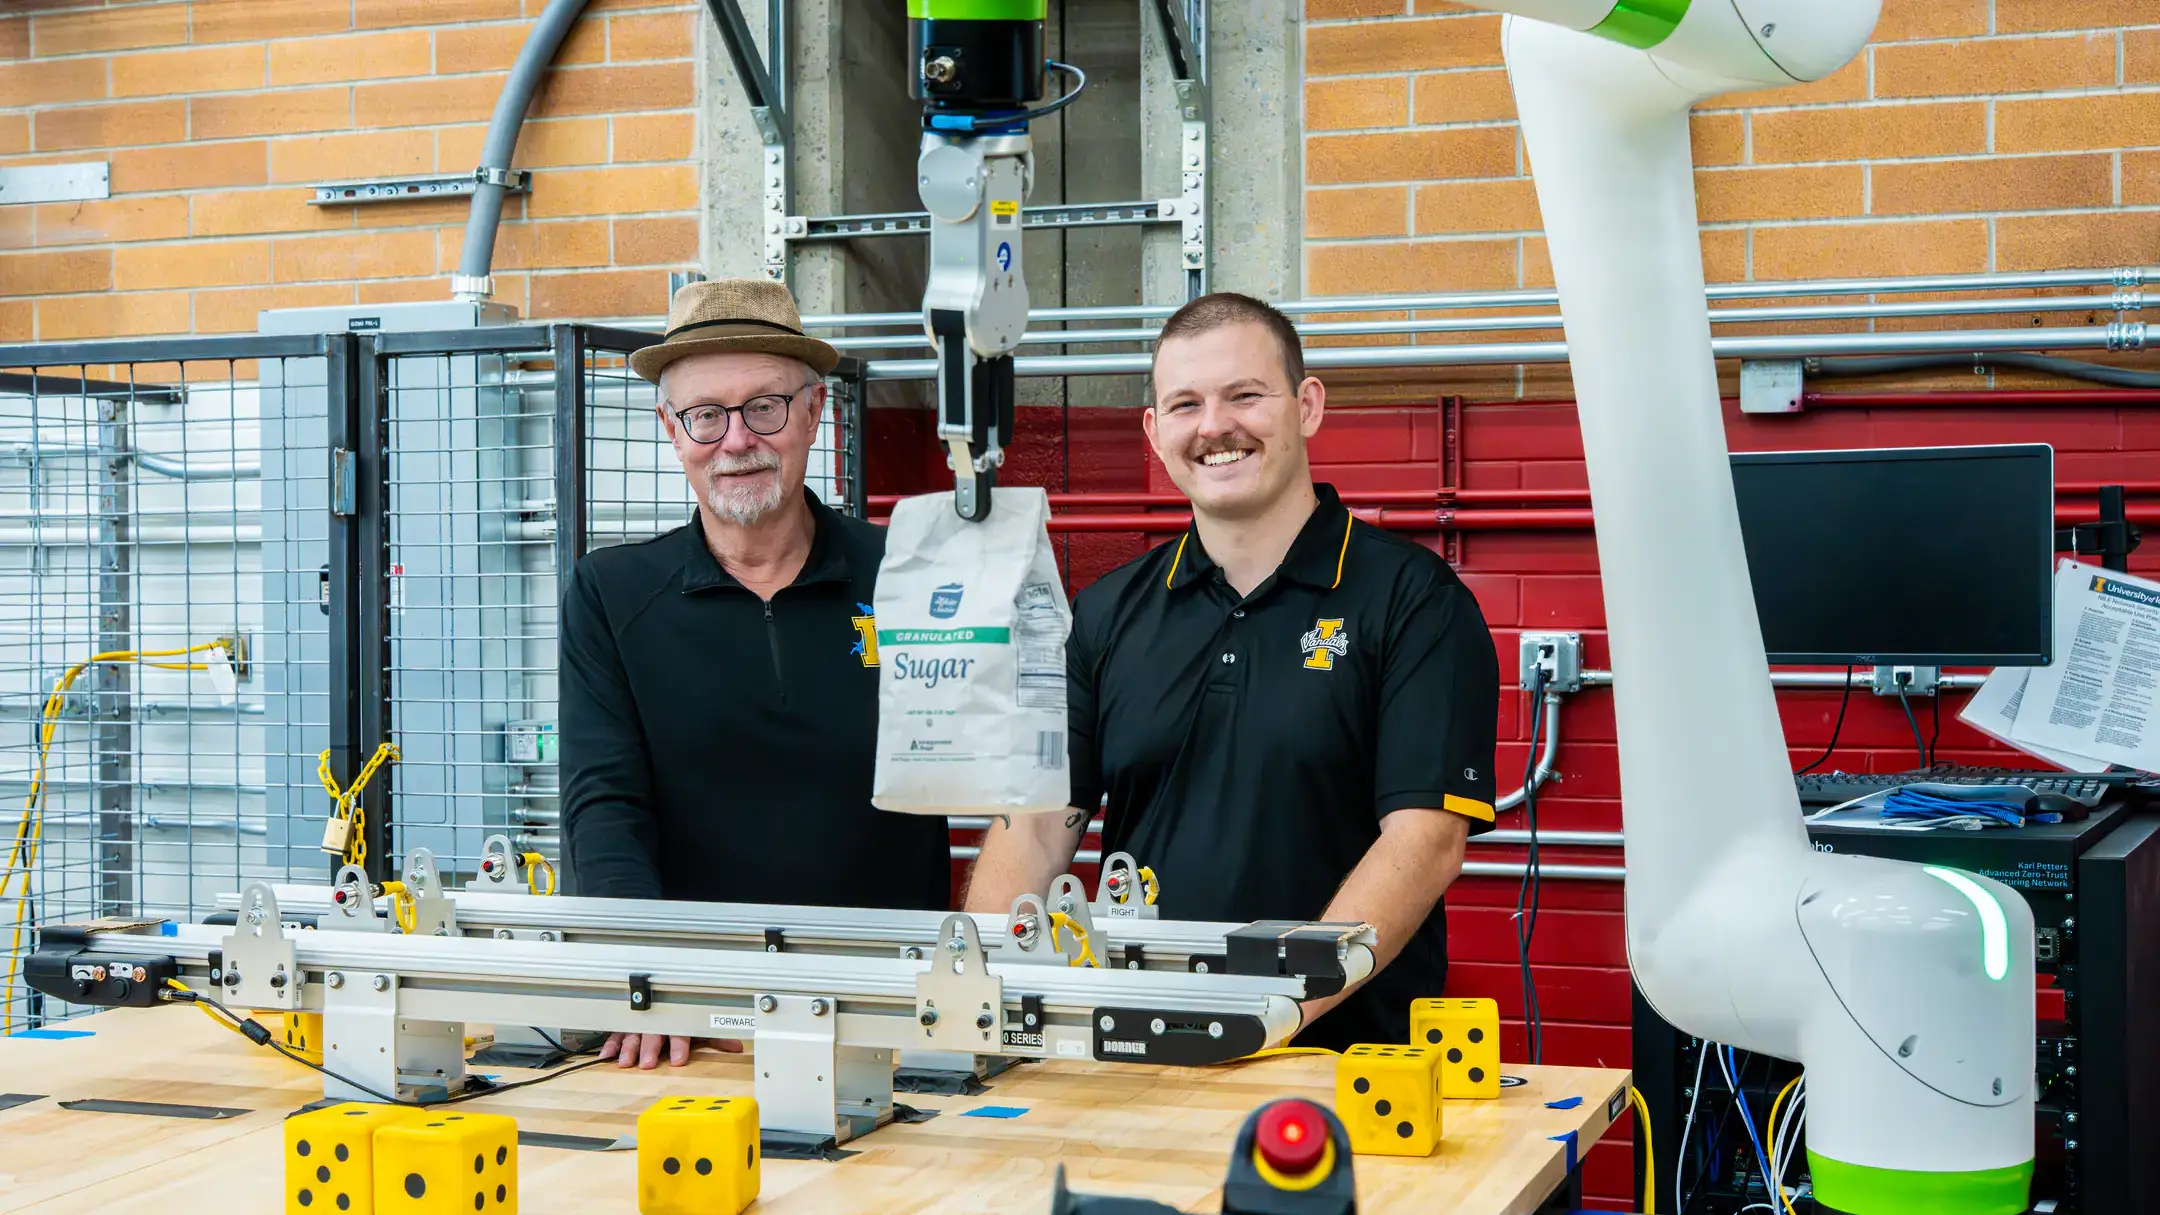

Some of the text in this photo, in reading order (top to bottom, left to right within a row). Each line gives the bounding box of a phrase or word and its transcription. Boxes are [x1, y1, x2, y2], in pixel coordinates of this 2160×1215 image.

[2107, 583, 2150, 602] University
[895, 630, 974, 642] GRANULATED
[894, 652, 975, 688] Sugar
[2037, 862, 2068, 870] Petters
[1979, 869, 2068, 879] Advanced Zero-Trust
[2031, 879, 2068, 887] Network
[1111, 908, 1135, 916] RIGHT
[714, 1017, 755, 1026] FORWARD
[1003, 1032, 1043, 1045] 0 SERIES
[1103, 1040, 1146, 1054] DORNER
